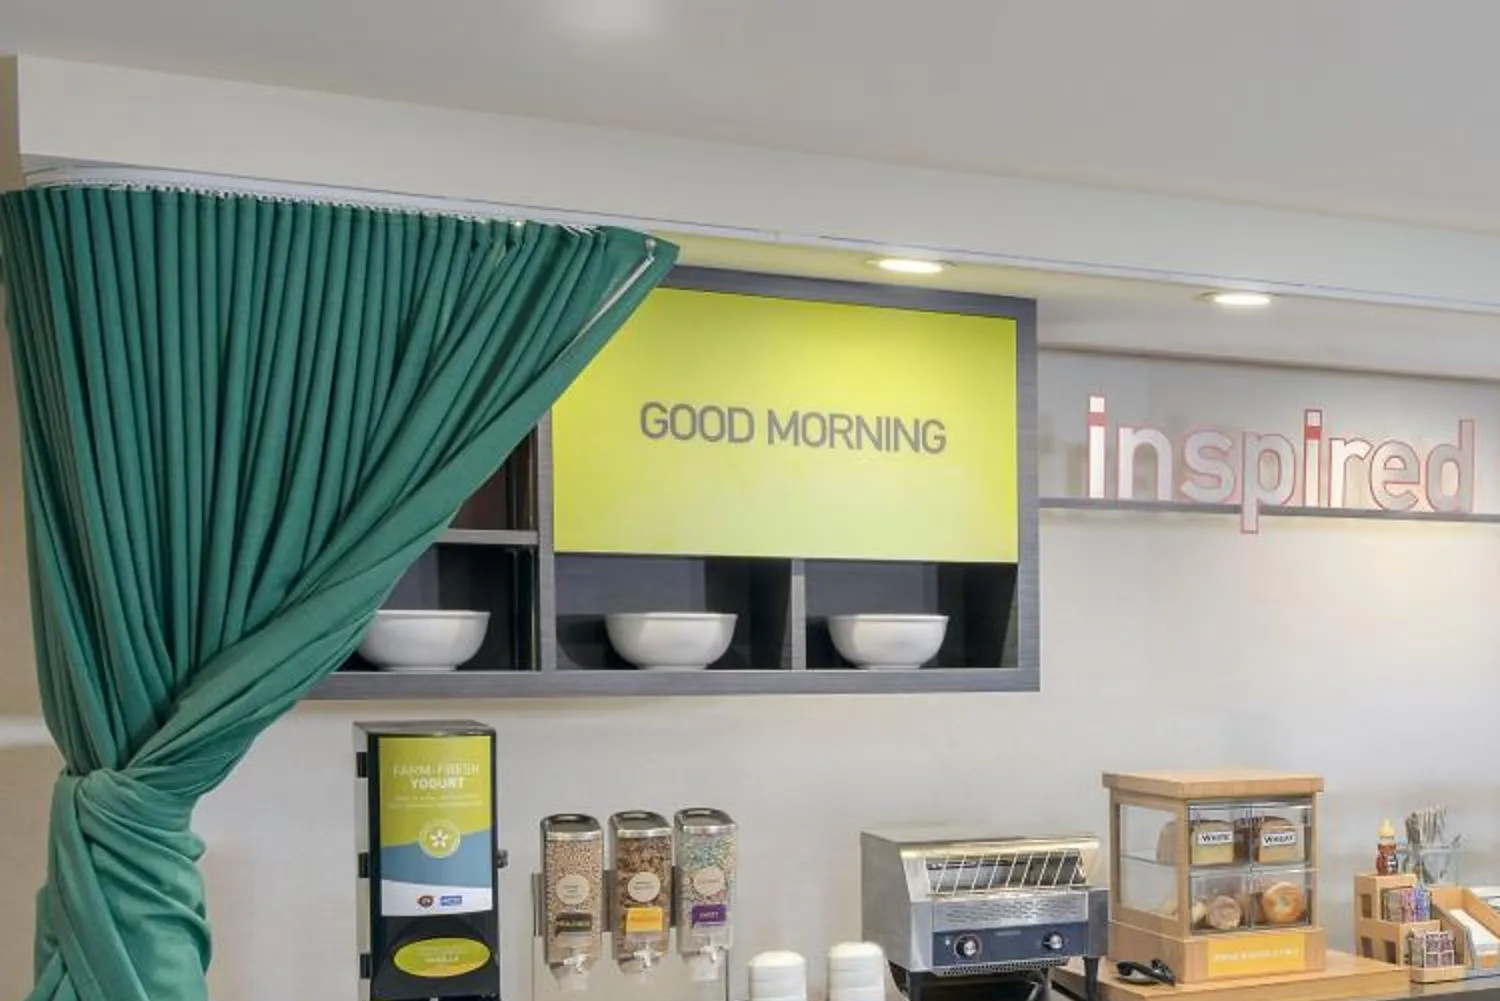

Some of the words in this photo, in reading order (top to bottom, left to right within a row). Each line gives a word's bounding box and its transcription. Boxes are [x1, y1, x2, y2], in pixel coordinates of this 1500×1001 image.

[640, 401, 755, 443] GOOD
[767, 409, 947, 454] MORNING
[1088, 396, 1474, 534] inspired
[393, 763, 479, 777] FARM-FRESH
[410, 777, 464, 789] YOGURT
